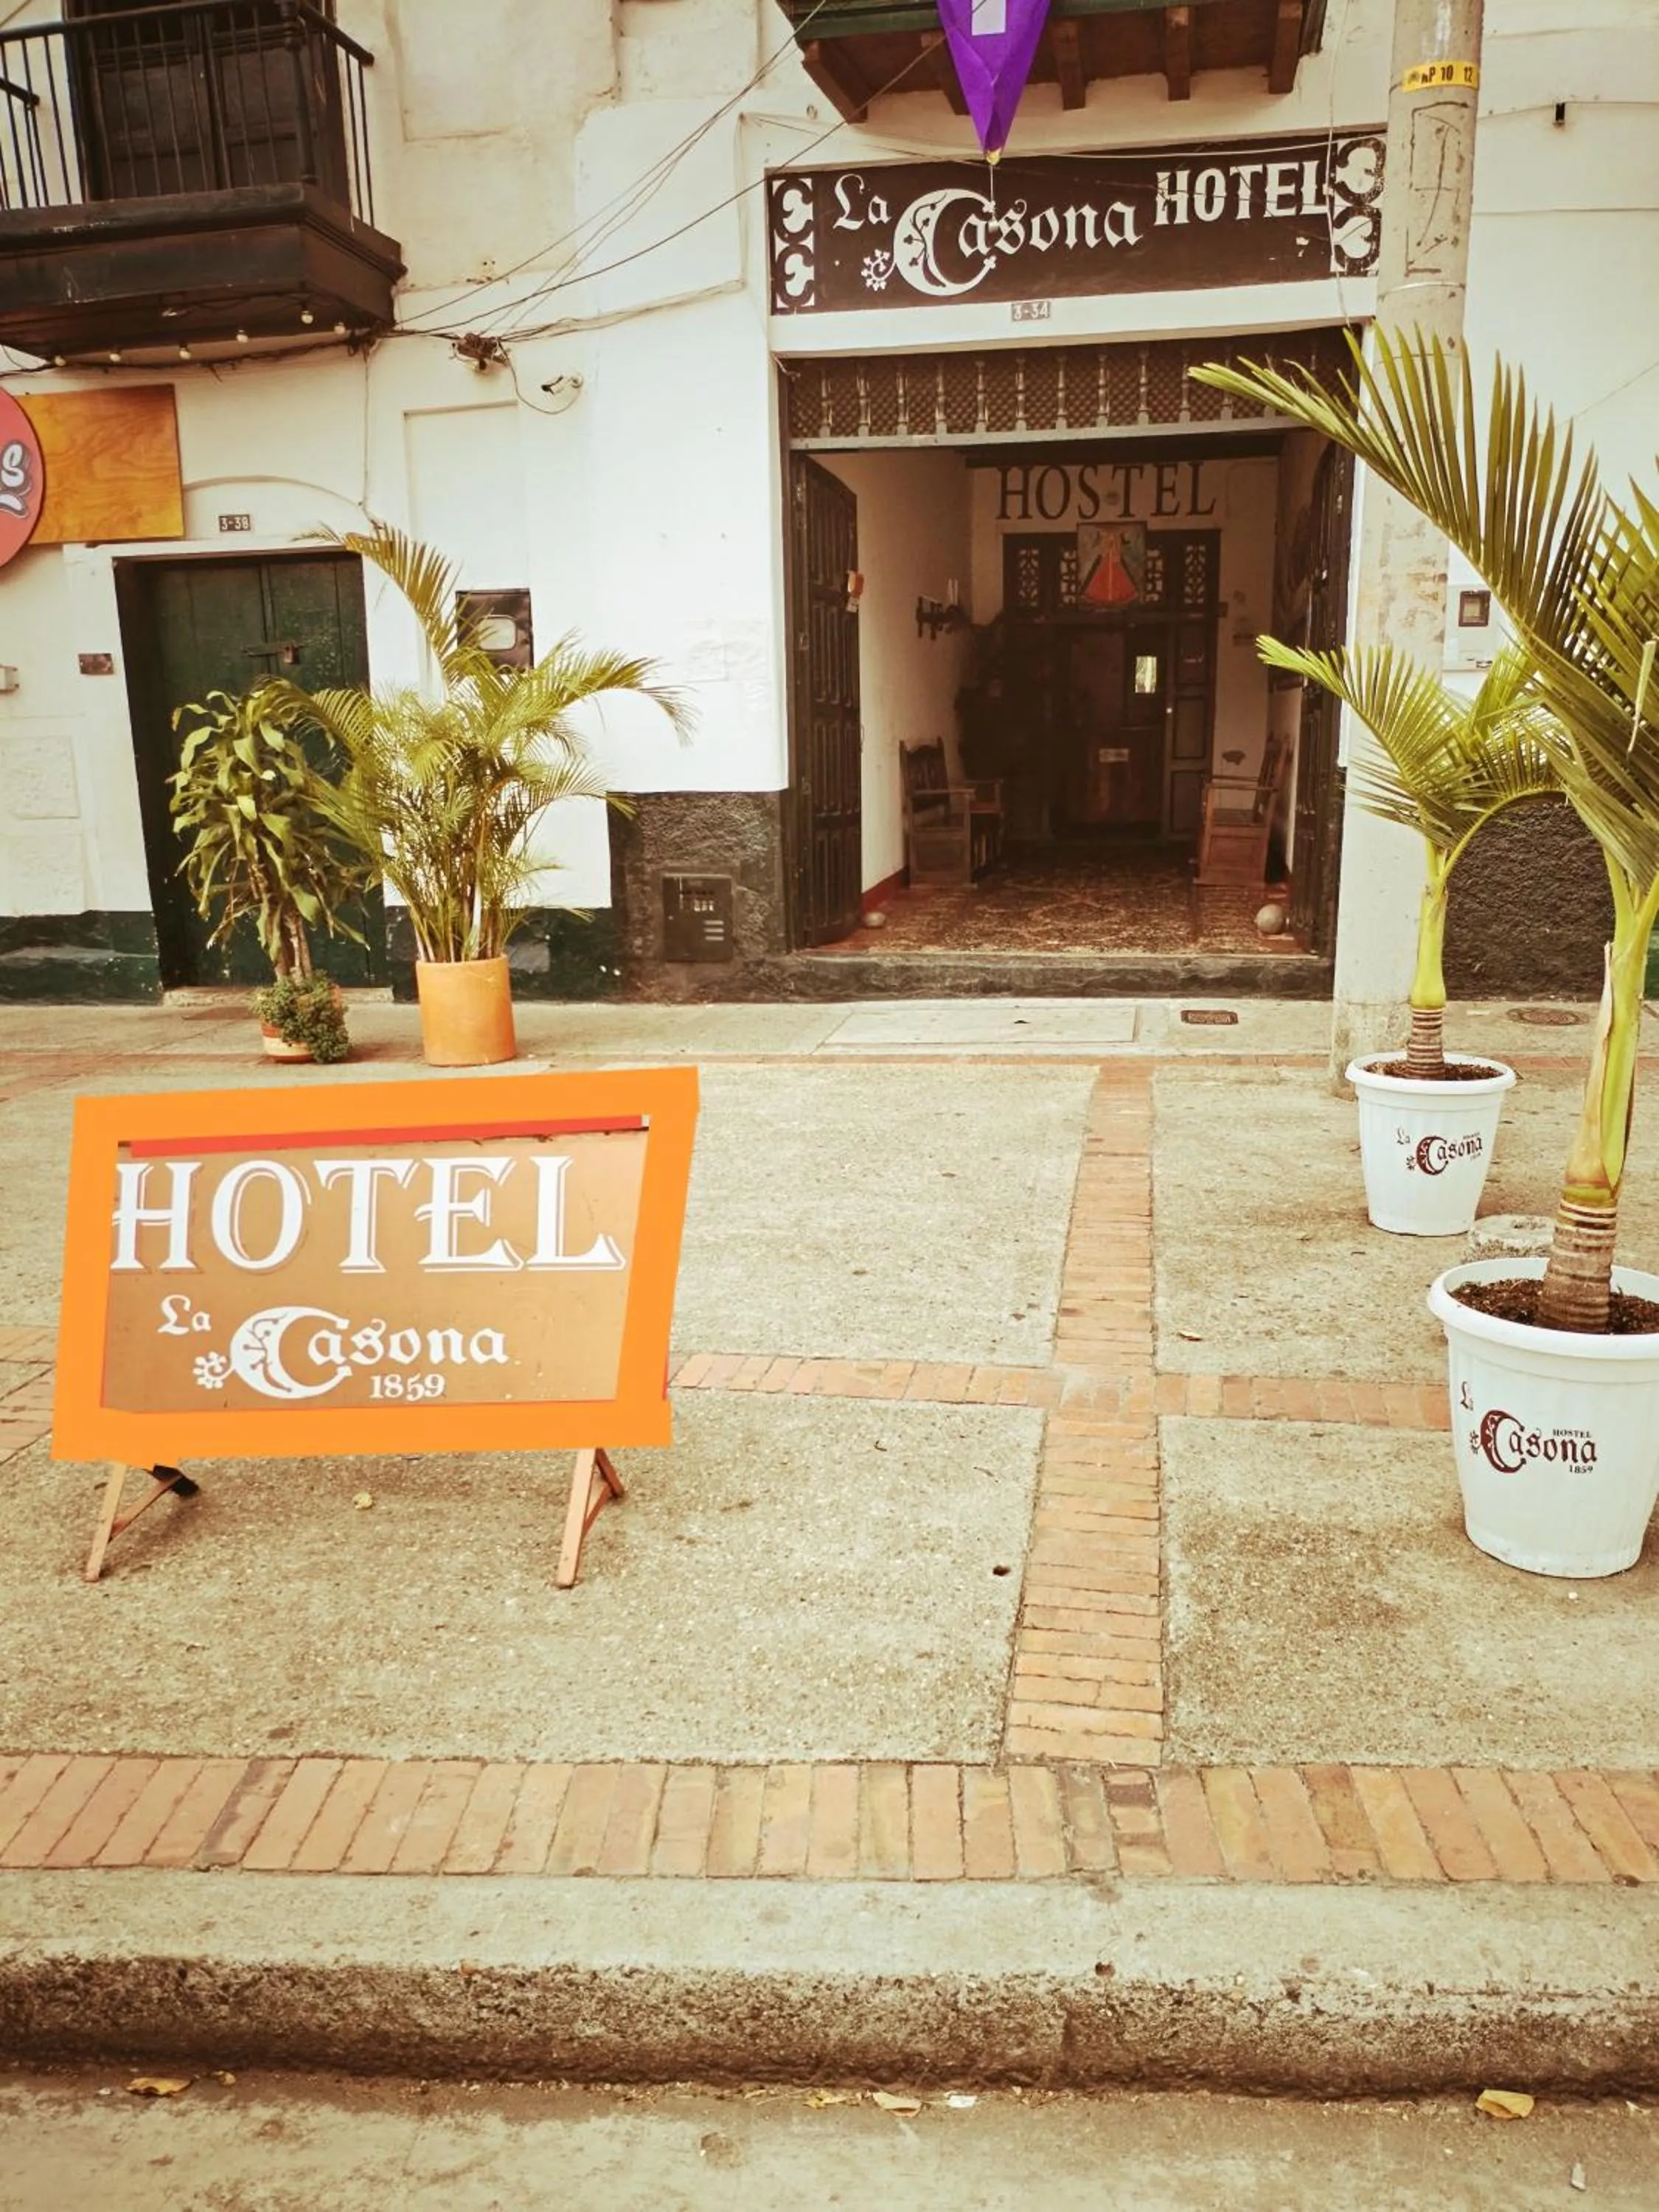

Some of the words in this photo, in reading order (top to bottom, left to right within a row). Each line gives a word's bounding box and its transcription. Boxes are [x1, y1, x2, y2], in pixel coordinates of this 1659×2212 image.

[1441, 64, 1454, 81] 10
[833, 174, 891, 231] La
[894, 188, 1143, 296] Casona
[1152, 160, 1330, 226] HOTEL
[995, 460, 1217, 520] HOSTEL
[1416, 1135, 1483, 1175] Casona
[111, 1155, 626, 1273] HOTEL
[158, 1294, 212, 1335] La
[229, 1305, 509, 1399] Casona
[369, 1373, 446, 1401] 1859
[1480, 1409, 1598, 1473] Casona
[1552, 1428, 1593, 1439] HOSTEL
[1568, 1464, 1593, 1475] 1859
